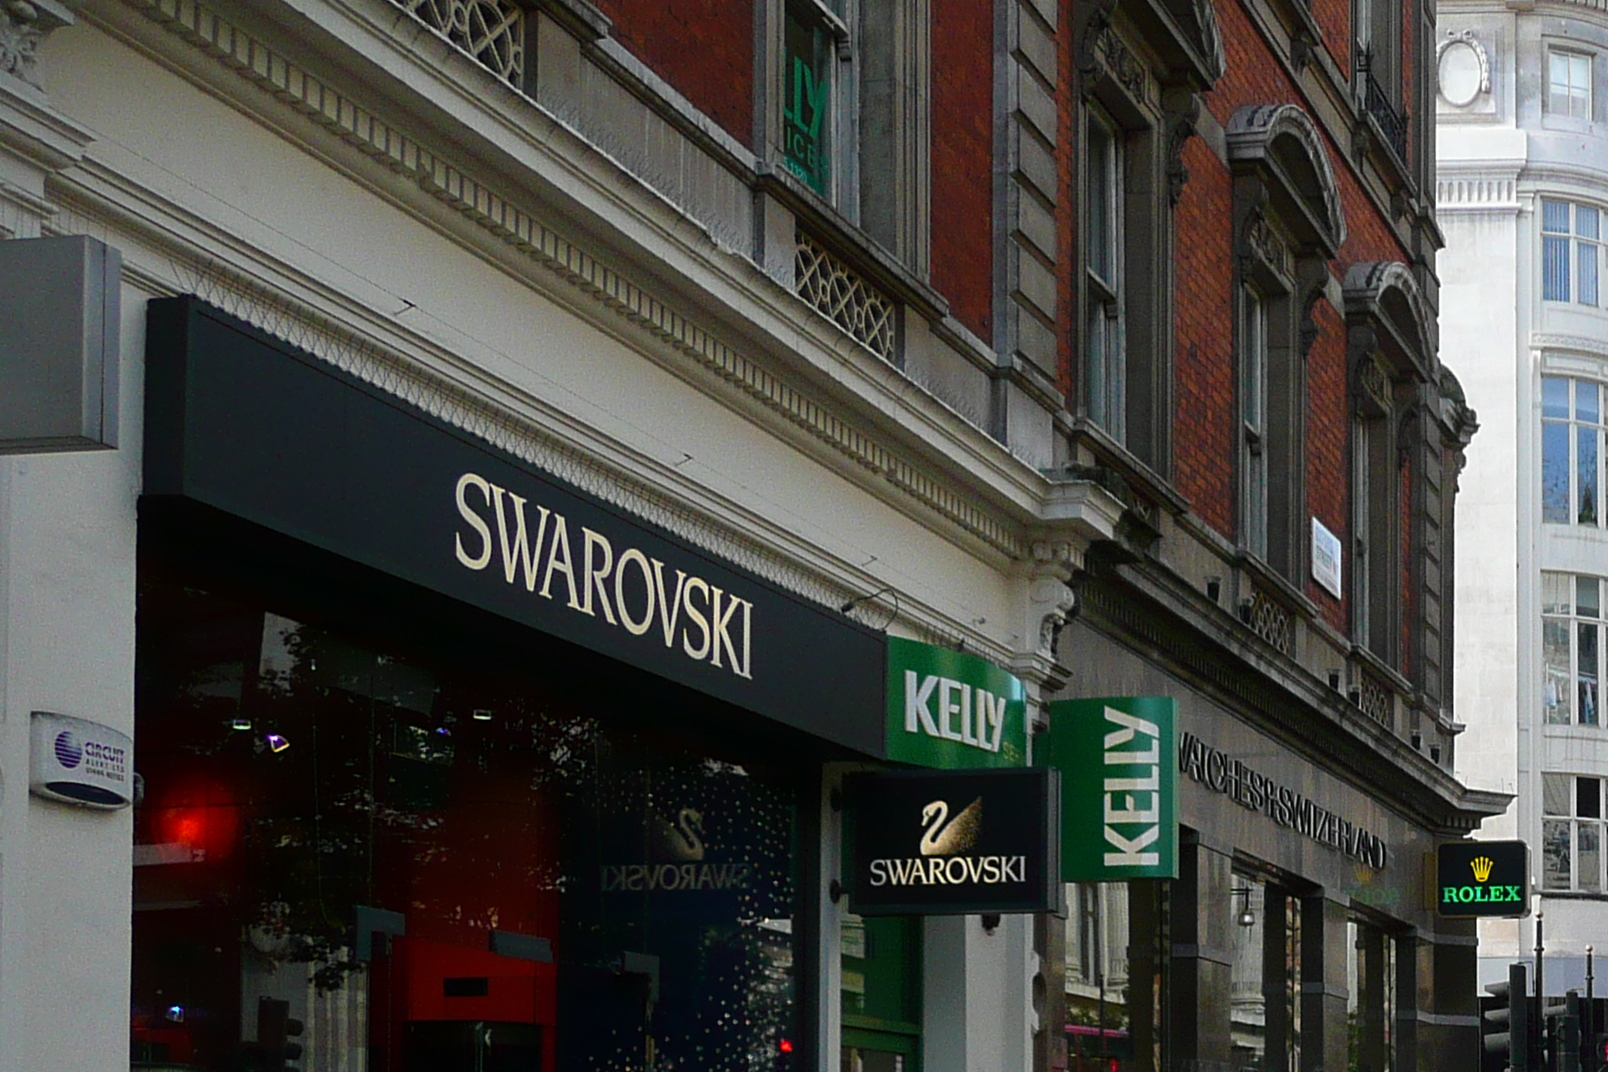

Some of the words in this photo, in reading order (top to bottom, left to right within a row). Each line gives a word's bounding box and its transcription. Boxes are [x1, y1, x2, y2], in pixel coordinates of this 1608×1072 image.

[455, 473, 753, 680] SWAROVSKI
[904, 669, 1006, 753] KELLY
[85, 742, 124, 764] CIRCUIT
[1103, 704, 1160, 867] KELLY
[869, 855, 1026, 887] SWAROVSKI
[1443, 884, 1521, 905] ROLEX
